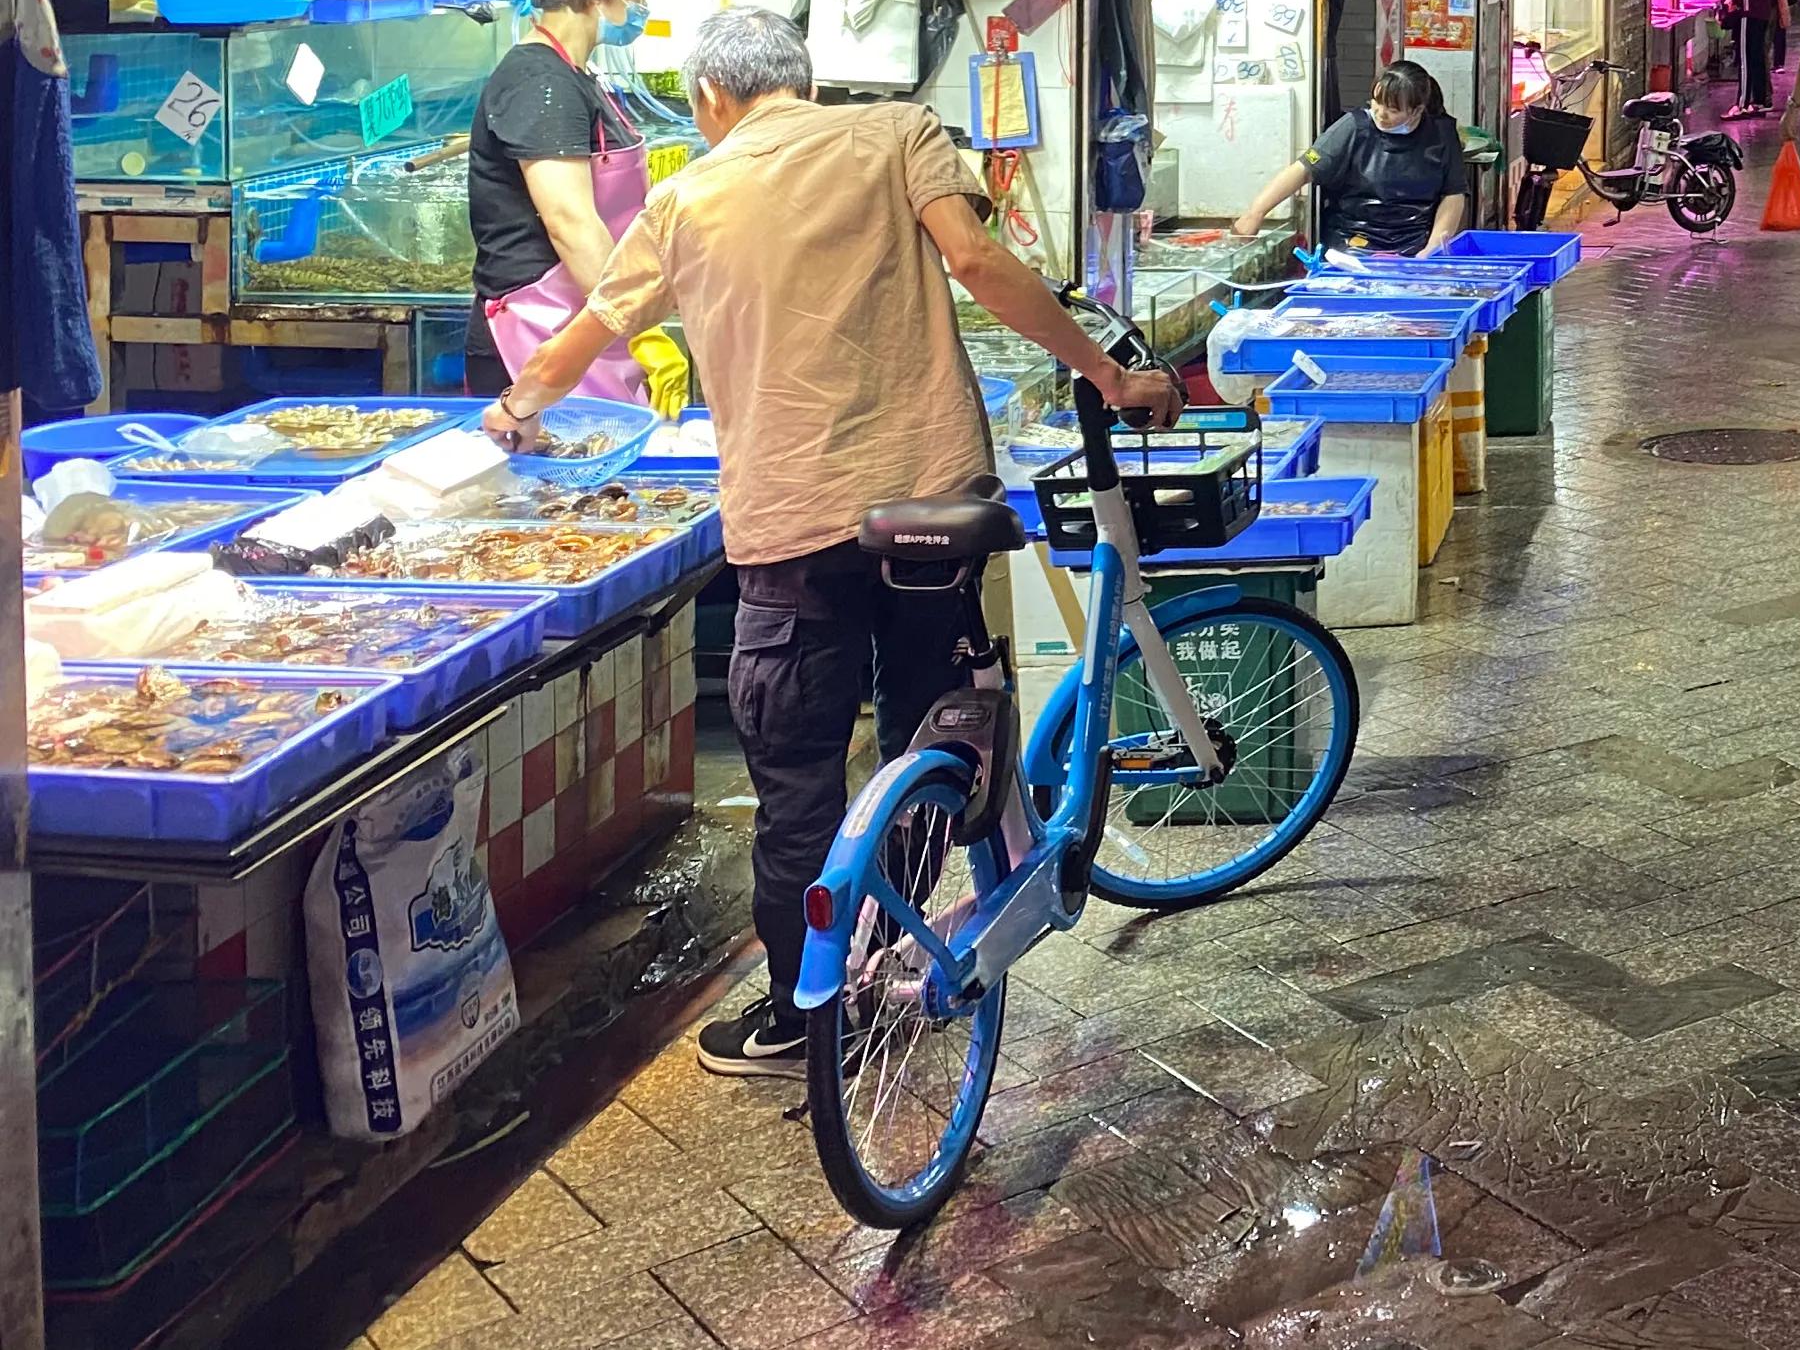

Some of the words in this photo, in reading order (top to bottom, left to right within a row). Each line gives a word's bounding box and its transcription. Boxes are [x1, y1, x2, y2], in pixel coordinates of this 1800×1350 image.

[167, 81, 220, 128] 26
[359, 1005, 395, 1121] 领先科技
